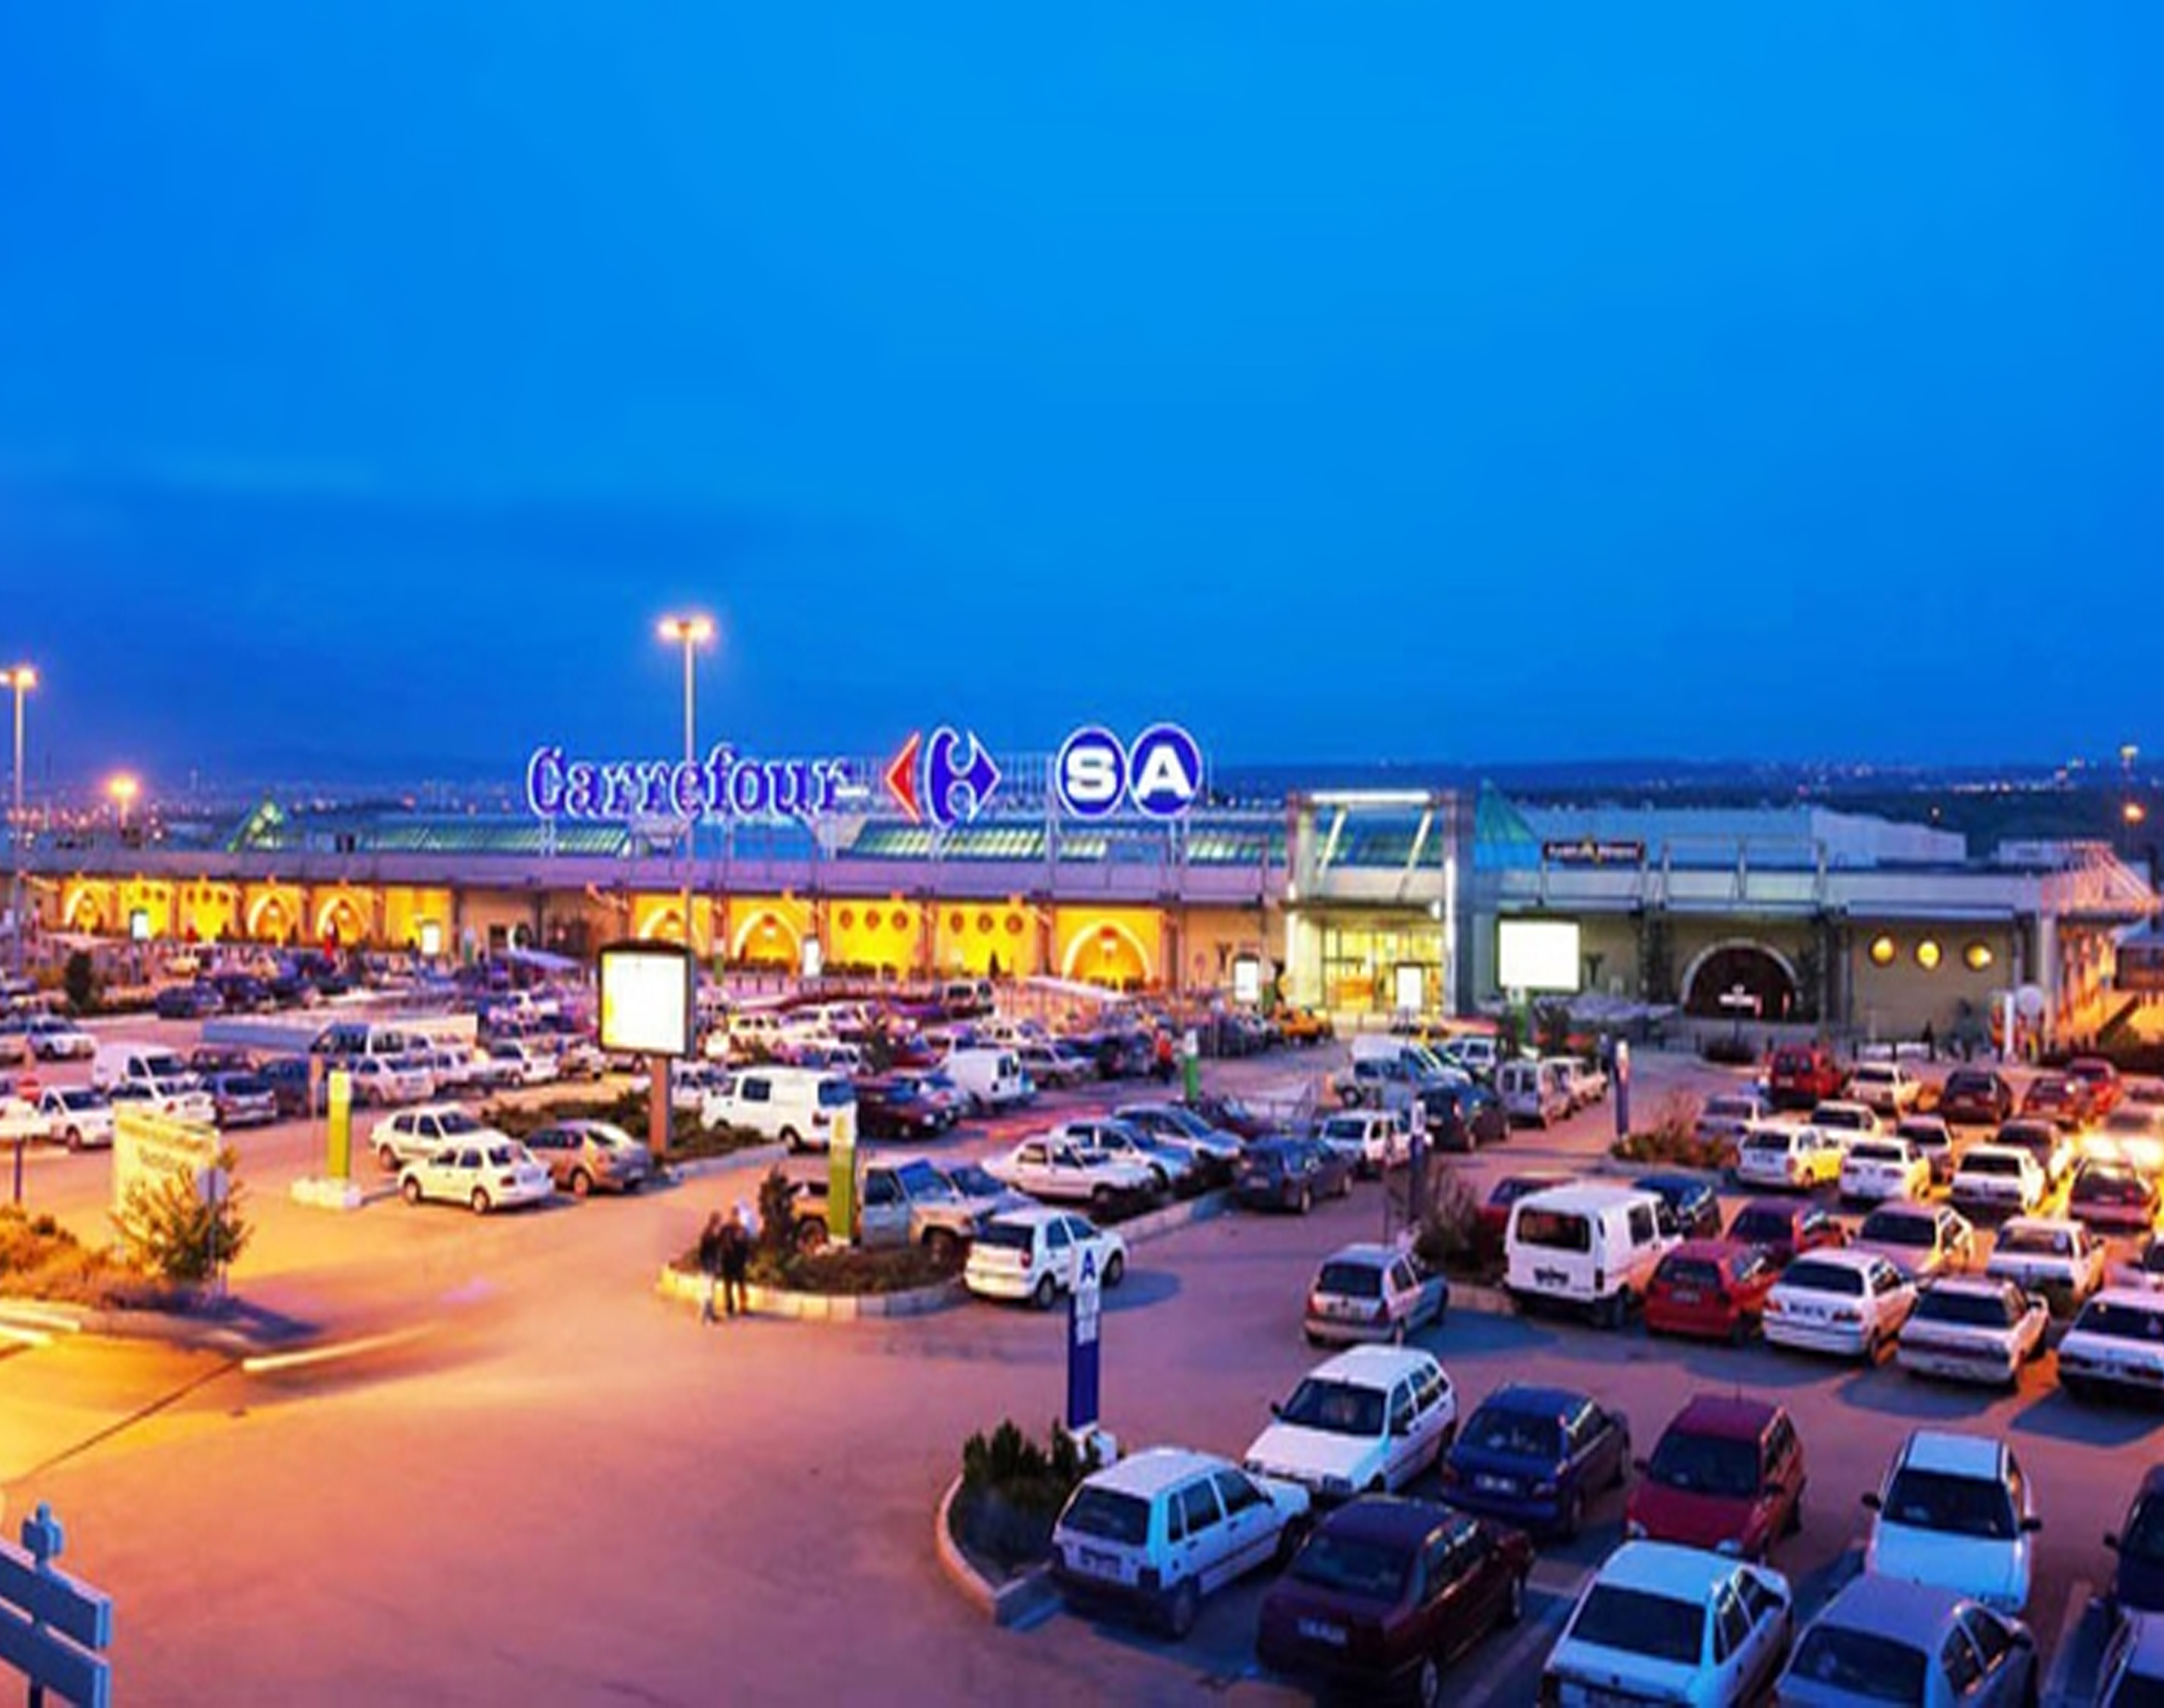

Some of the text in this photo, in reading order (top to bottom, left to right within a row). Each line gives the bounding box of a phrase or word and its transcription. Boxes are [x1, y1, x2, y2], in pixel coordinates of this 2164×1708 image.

[528, 743, 1194, 819] Carrefour SA
[1080, 1248, 1097, 1283] A
